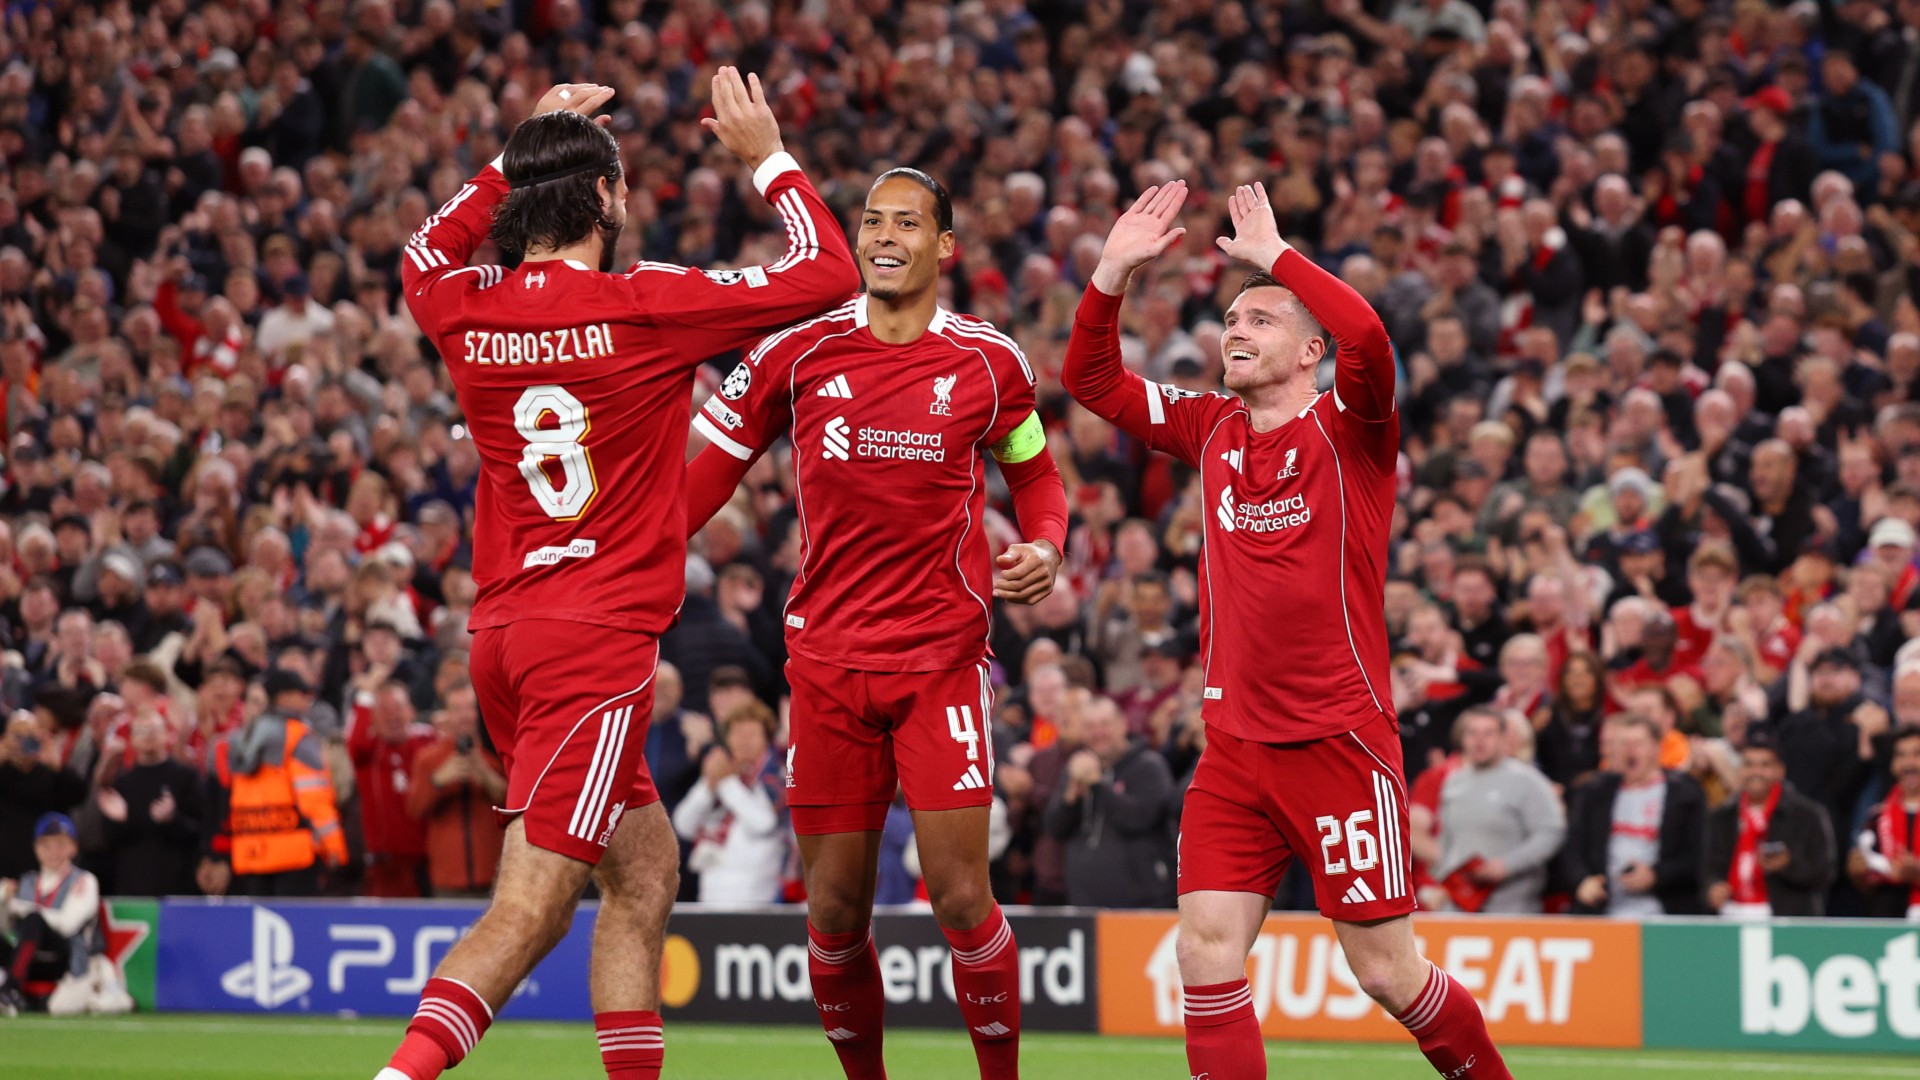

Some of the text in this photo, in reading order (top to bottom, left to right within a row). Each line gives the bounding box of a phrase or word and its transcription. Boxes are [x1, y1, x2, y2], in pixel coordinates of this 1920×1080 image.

[464, 323, 615, 365] SZOBOSZLAI
[513, 385, 599, 521] 8
[857, 426, 942, 447] standard
[857, 441, 945, 463] chartered
[1235, 507, 1310, 533] chartered
[946, 705, 979, 761] 4
[1315, 809, 1379, 876] 26
[328, 924, 527, 996] PS
[715, 929, 1085, 1001] maerrd
[1249, 932, 1594, 1025] JUS EAT
[1740, 924, 1920, 1040] bet
[966, 991, 1008, 1006] LFC
